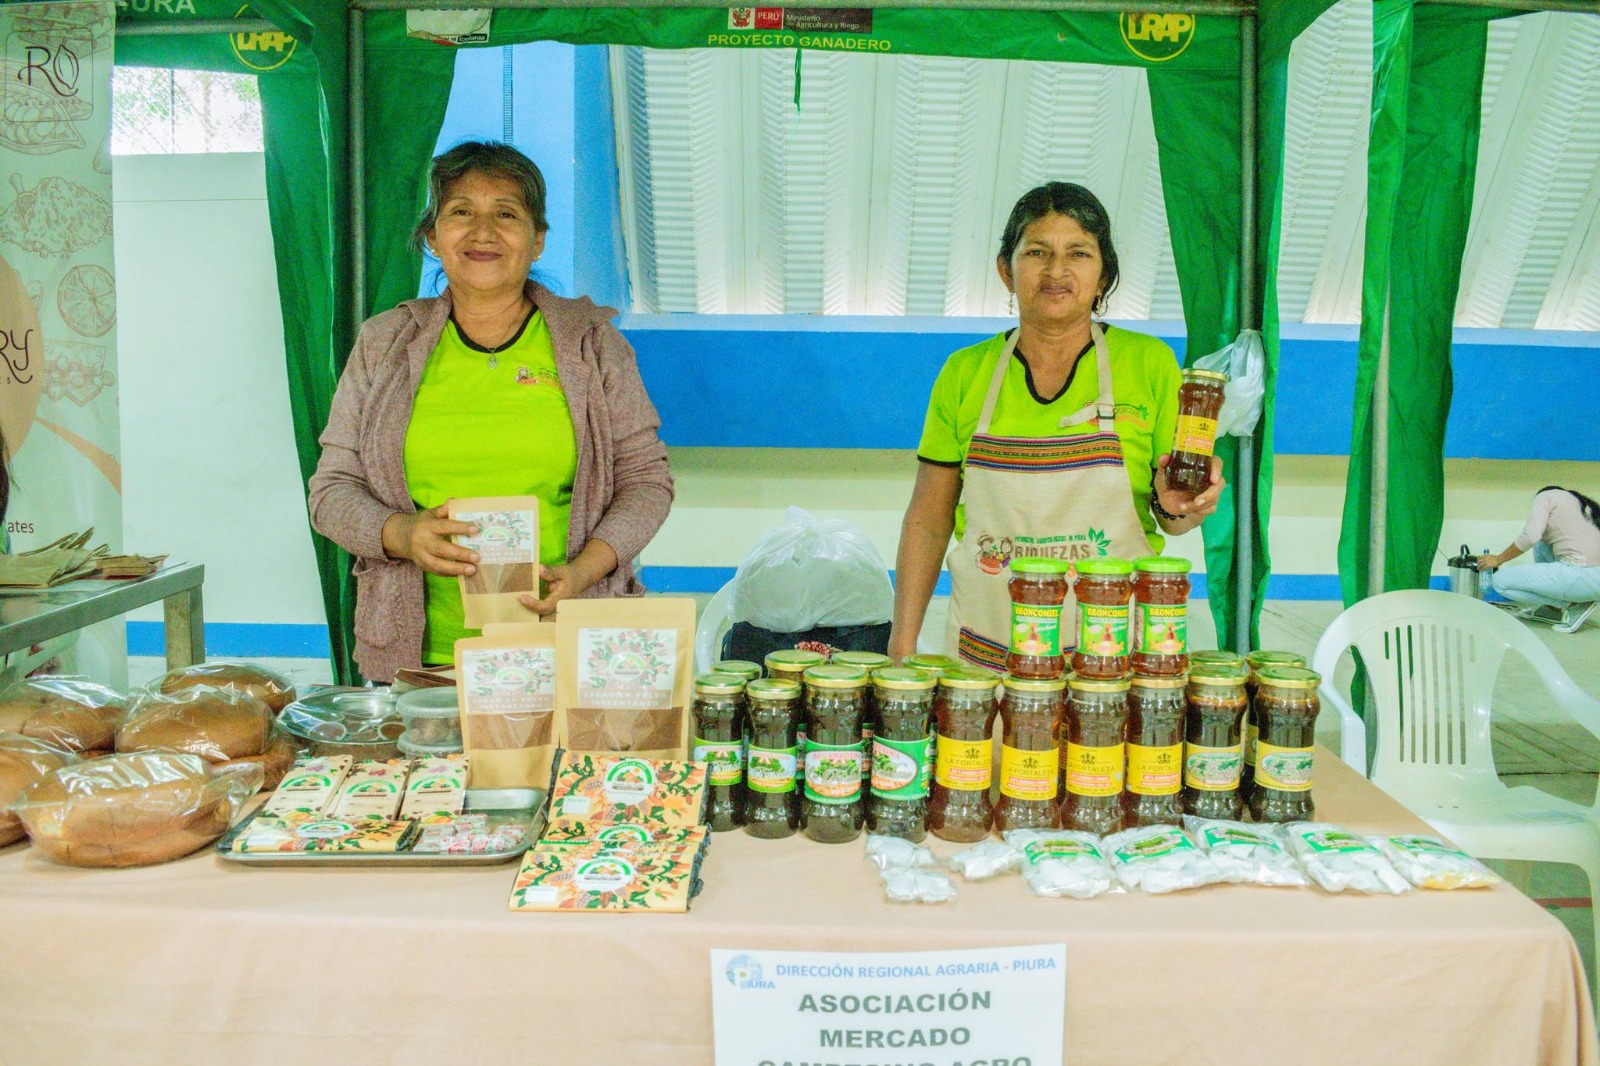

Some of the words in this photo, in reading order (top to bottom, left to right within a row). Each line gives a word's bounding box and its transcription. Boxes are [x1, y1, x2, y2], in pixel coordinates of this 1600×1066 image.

[757, 12, 780, 20] PERÚ
[707, 34, 794, 46] PROYECTO
[799, 37, 891, 50] GANADERO
[7, 520, 35, 533] ates
[776, 964, 853, 977] DIRECCIÓN
[858, 966, 931, 977] REGIONAL
[935, 961, 1000, 975] AGRARIA
[1012, 957, 1056, 971] PIURA
[798, 988, 991, 1014] ASOCIACIÓN
[819, 1027, 971, 1048] MERCADO
